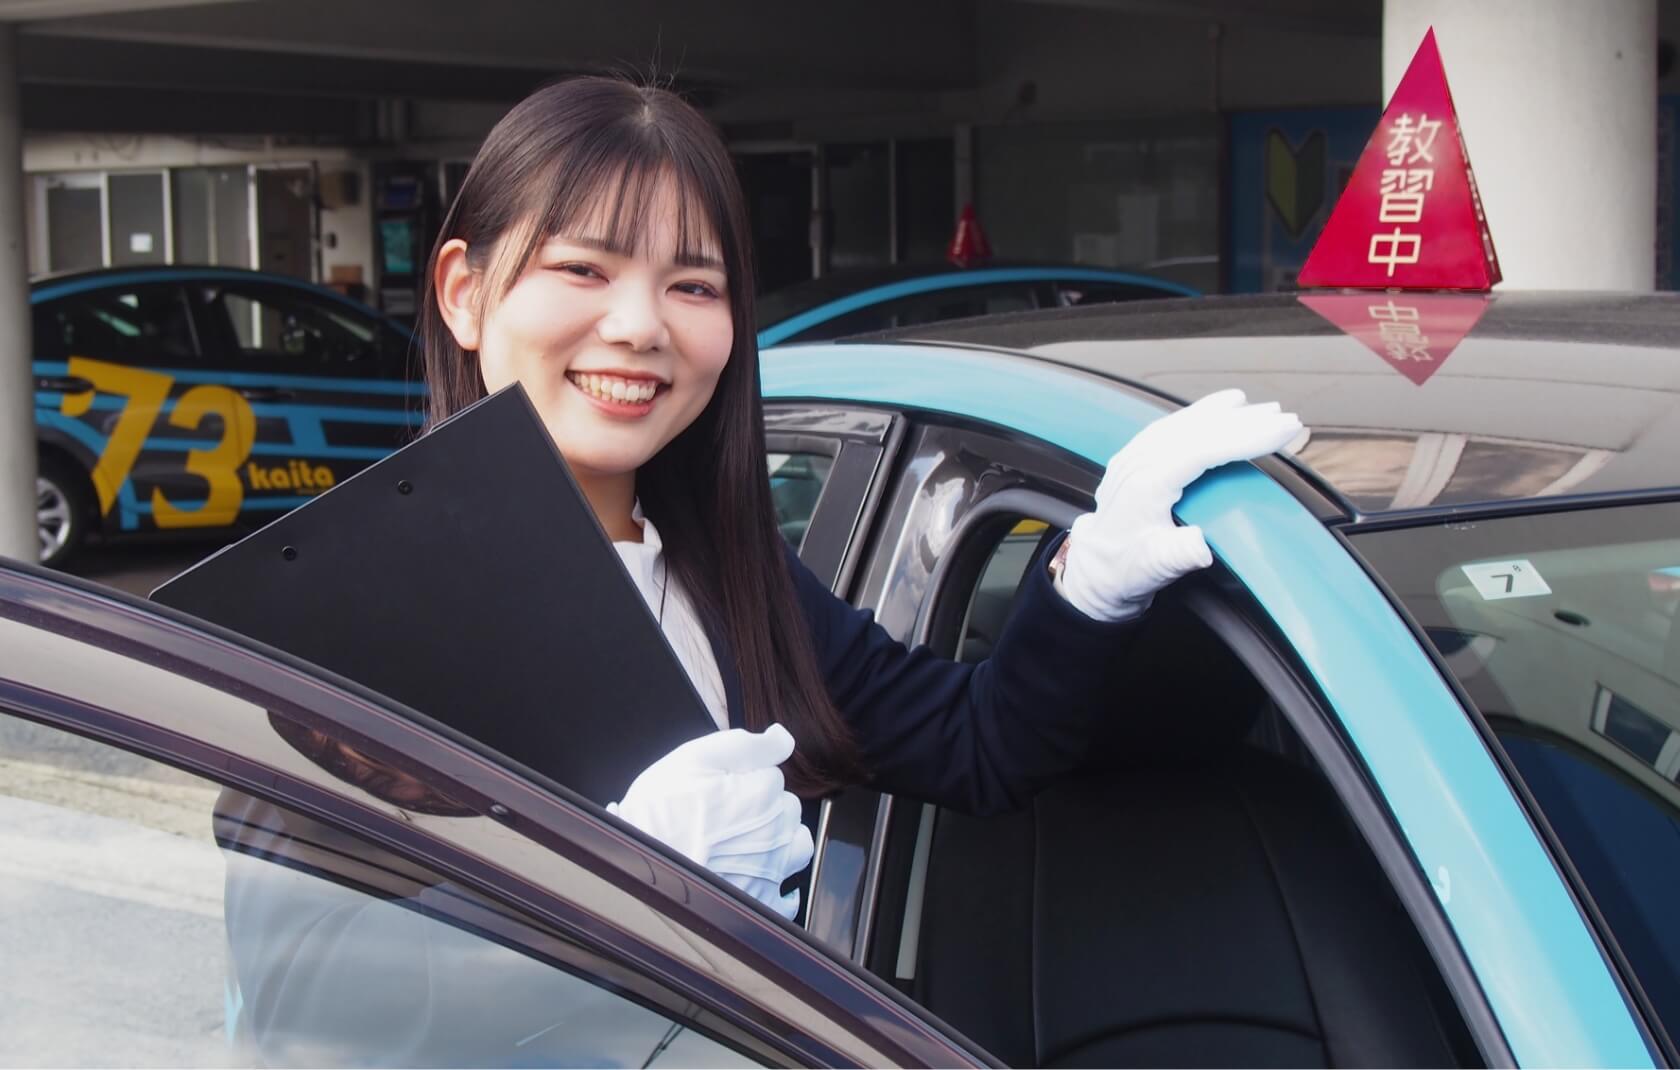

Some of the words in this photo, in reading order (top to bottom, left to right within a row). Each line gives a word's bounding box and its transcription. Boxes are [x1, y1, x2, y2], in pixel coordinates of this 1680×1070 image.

[1368, 113, 1442, 277] 教習中
[248, 459, 334, 489] kaita
[1490, 574, 1513, 592] 7
